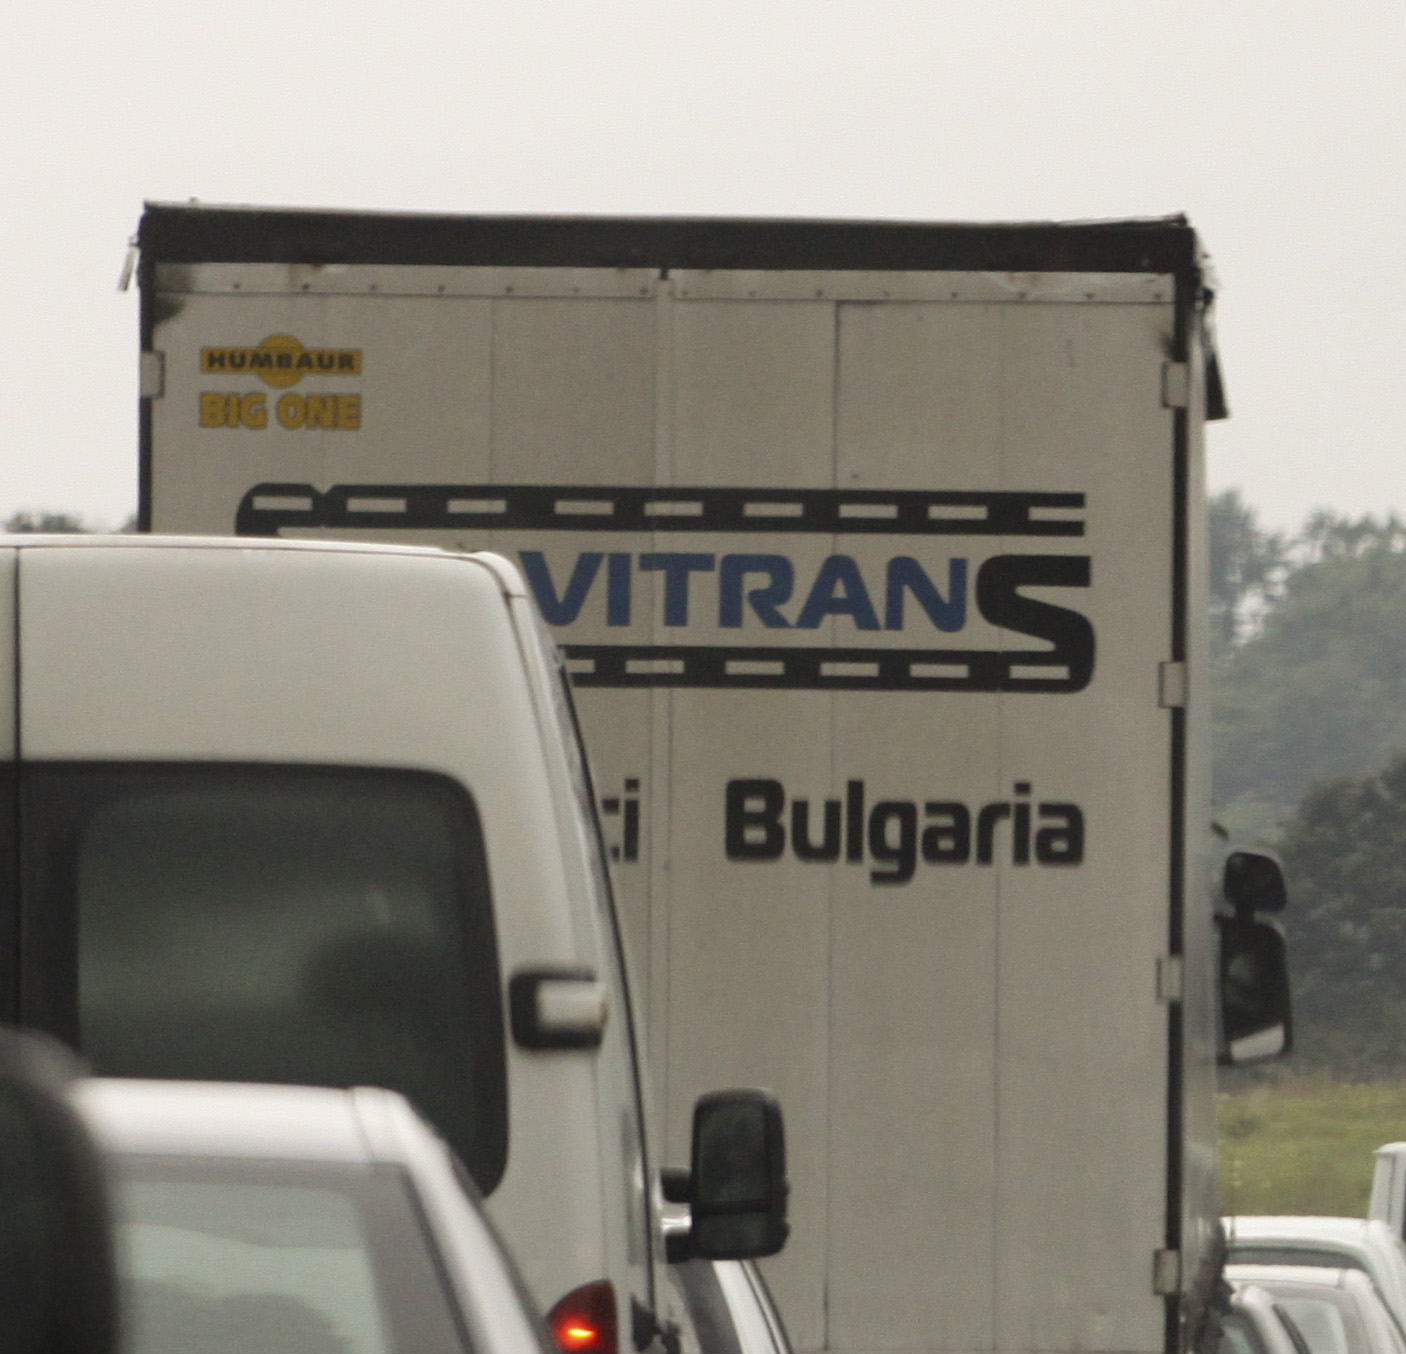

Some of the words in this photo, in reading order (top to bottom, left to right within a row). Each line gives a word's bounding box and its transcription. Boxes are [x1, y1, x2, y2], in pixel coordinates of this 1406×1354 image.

[207, 352, 355, 369] HUMBAUR
[200, 393, 268, 428] BIG
[276, 393, 362, 430] ONE
[725, 778, 1084, 887] Bulgaria
